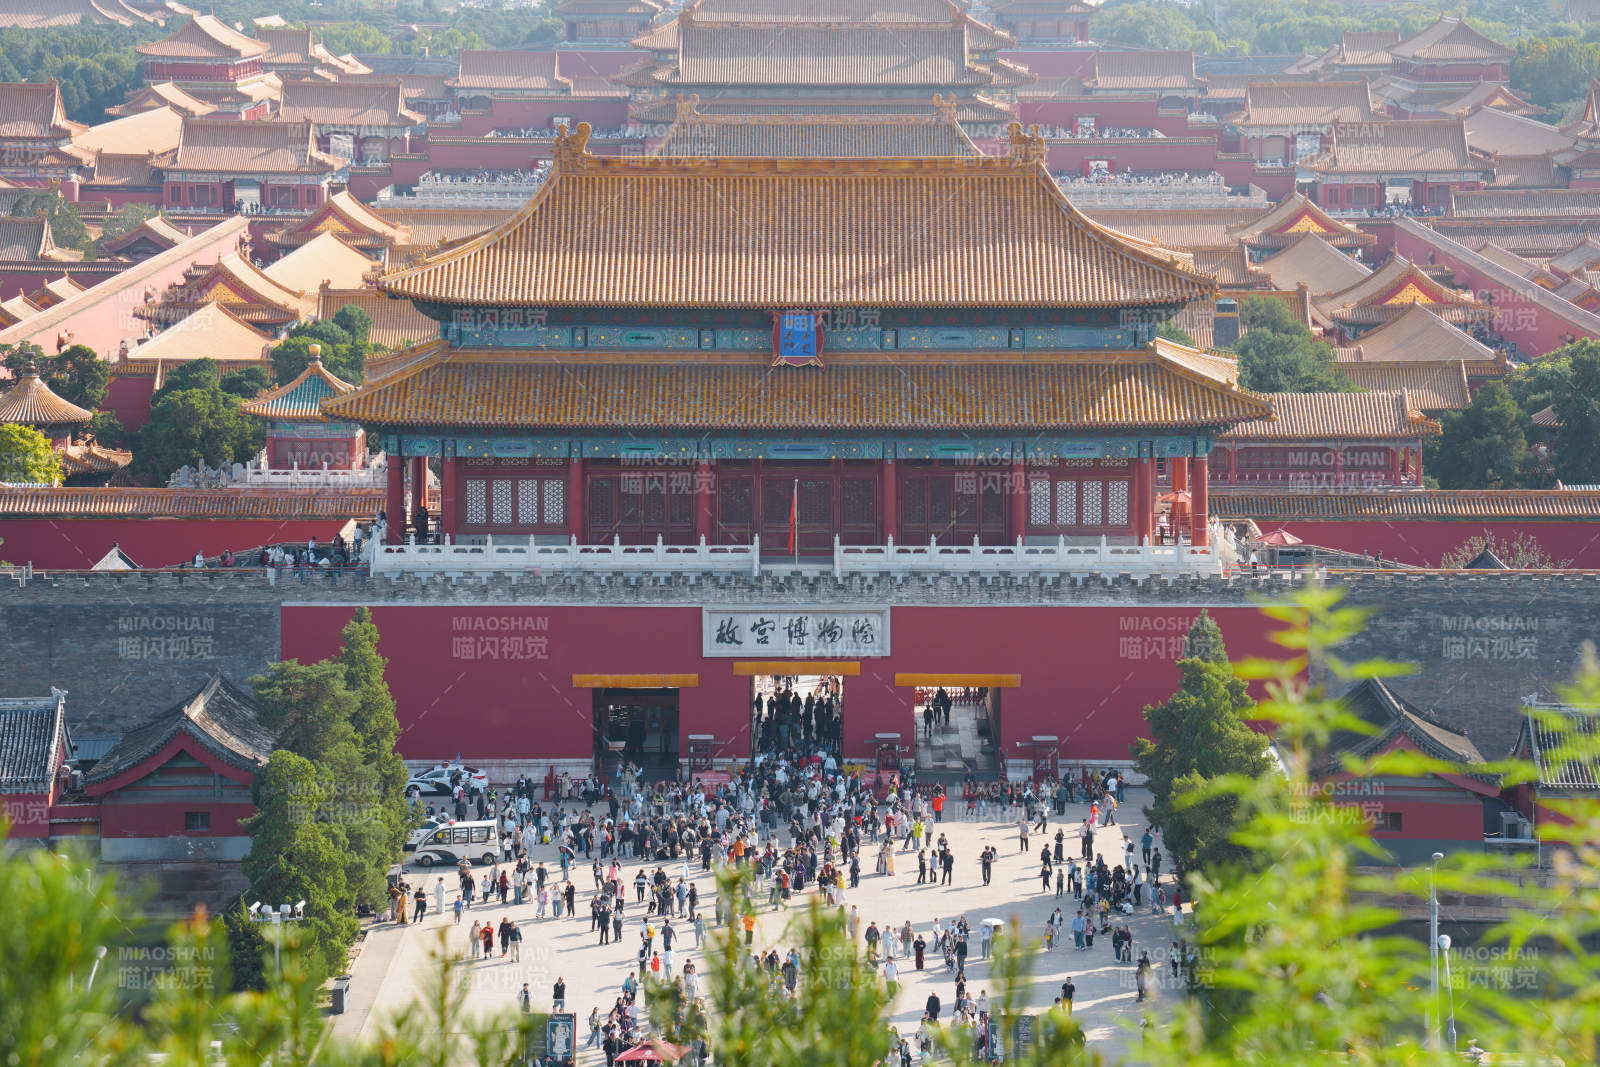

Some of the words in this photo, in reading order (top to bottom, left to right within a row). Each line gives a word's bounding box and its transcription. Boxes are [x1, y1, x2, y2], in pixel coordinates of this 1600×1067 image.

[715, 615, 875, 646] 故宫博物院
